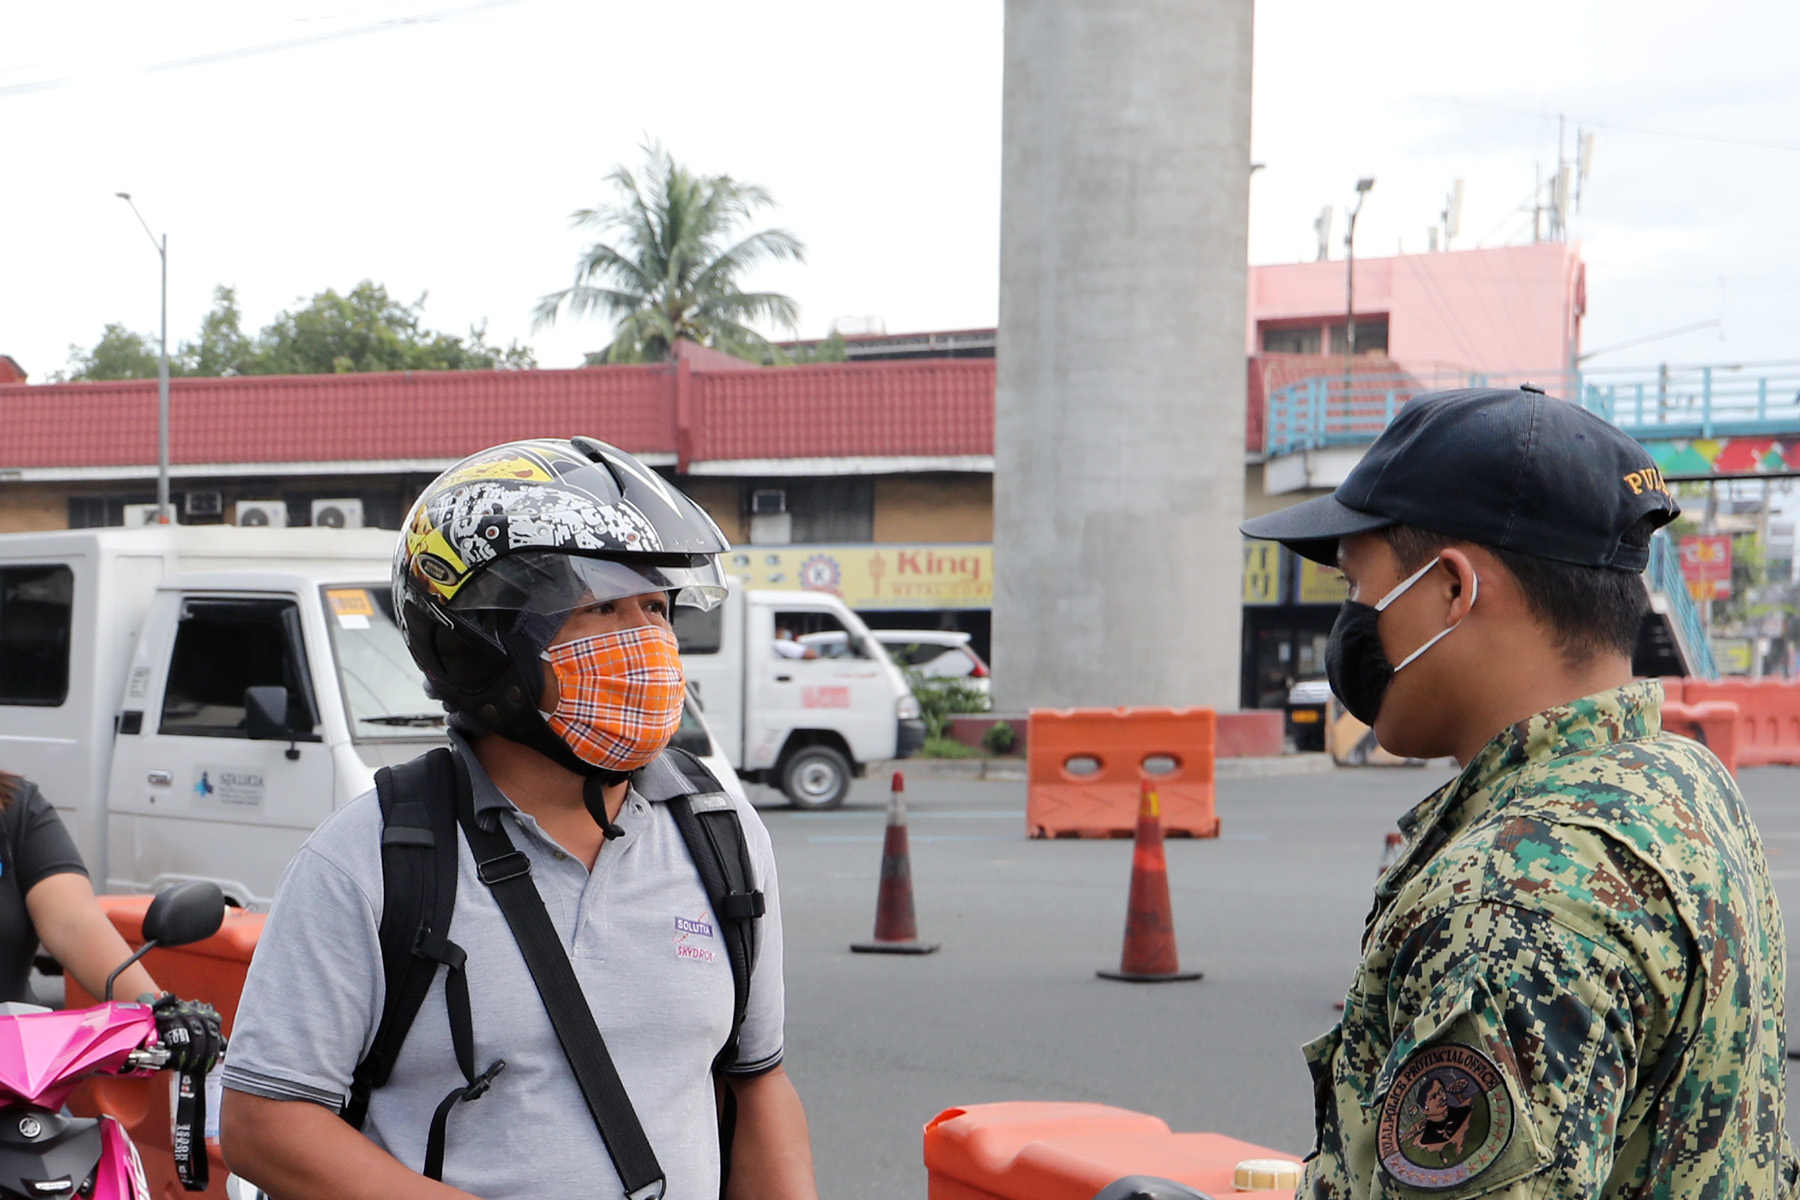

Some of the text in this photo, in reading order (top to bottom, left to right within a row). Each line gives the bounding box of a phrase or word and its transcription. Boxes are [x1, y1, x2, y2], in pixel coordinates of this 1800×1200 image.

[898, 550, 980, 581] King
[677, 919, 711, 935] SOLUTIA
[677, 945, 714, 962] SKYDROL
[1384, 1082, 1406, 1120] POLICE
[1404, 1050, 1465, 1083] PROVINCIAL
[1463, 1053, 1499, 1090] OFFICE
[179, 1123, 191, 1162] MOUSE
